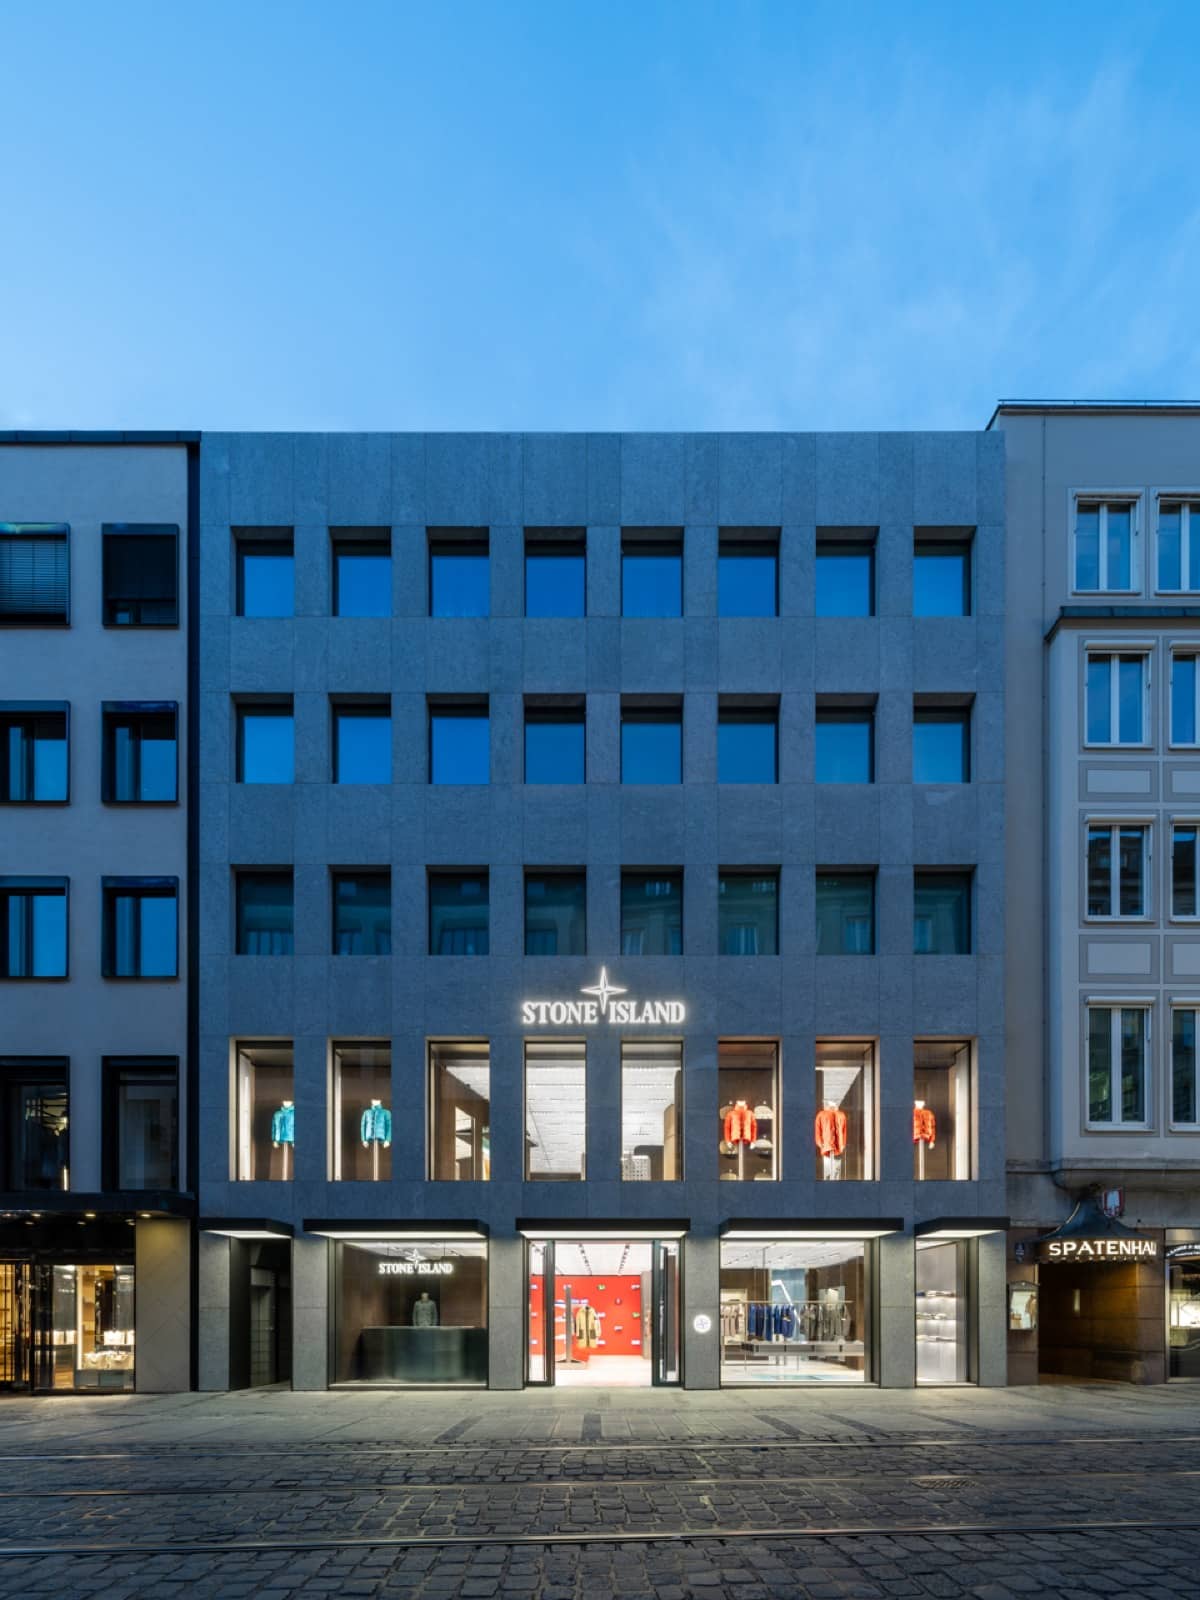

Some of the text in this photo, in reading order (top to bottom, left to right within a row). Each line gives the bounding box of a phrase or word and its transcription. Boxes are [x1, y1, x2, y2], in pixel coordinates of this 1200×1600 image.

[522, 1001, 686, 1025] STONE ISLAND
[378, 1263, 454, 1274] STONE ISLAND
